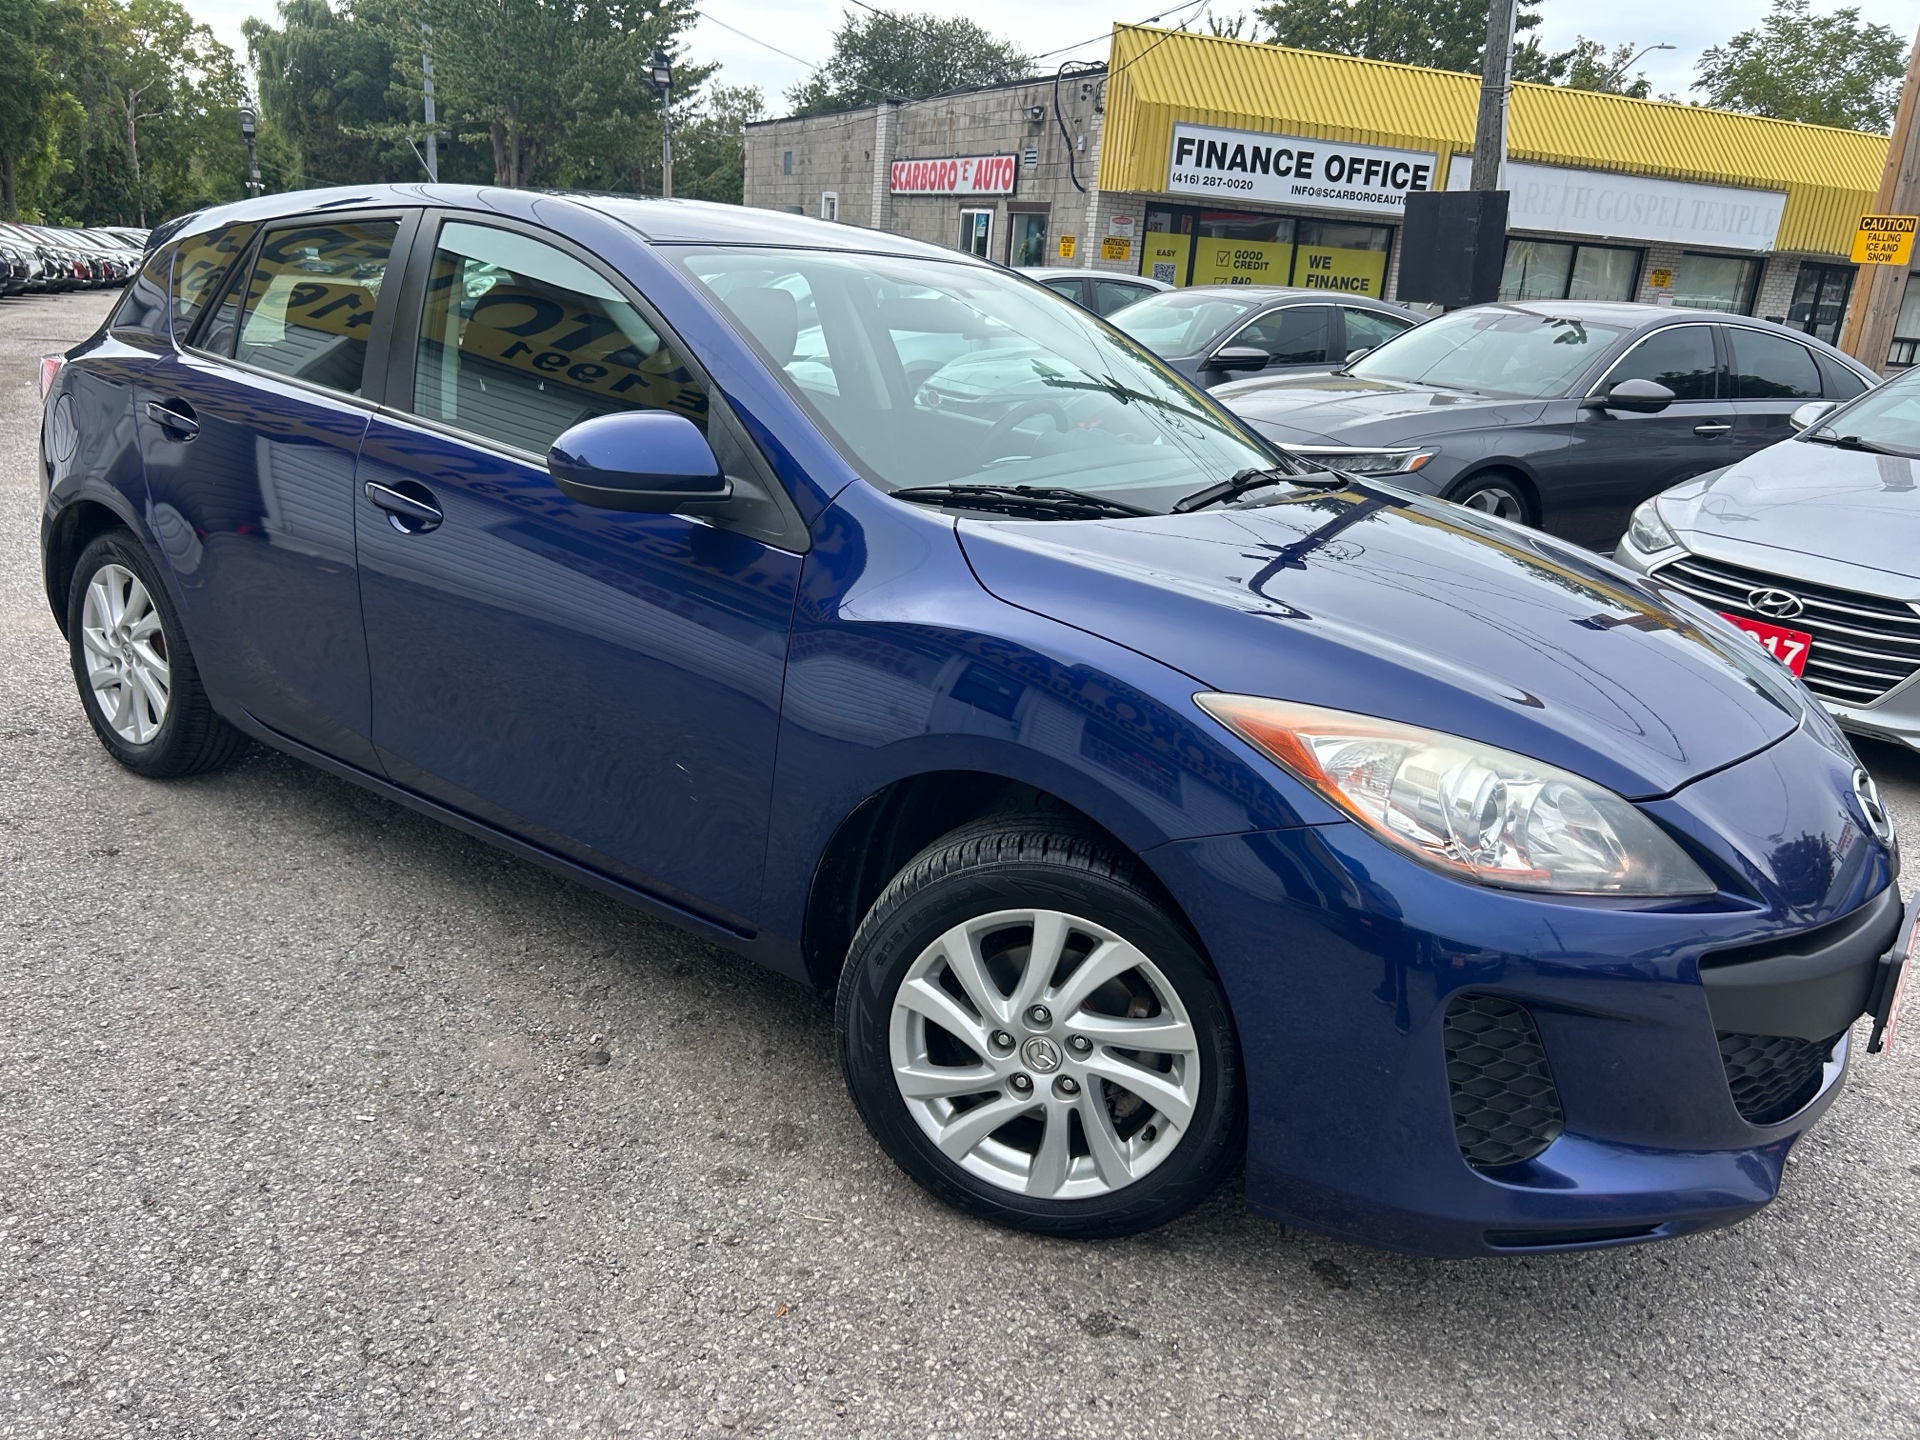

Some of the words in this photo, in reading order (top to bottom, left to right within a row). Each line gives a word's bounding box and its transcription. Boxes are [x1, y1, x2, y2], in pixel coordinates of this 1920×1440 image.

[1175, 137, 1314, 179] FINANCE
[1324, 154, 1430, 190] OFFICE
[891, 160, 958, 191] SCARBORO
[972, 157, 1014, 191] AUTO
[1172, 172, 1199, 185] (416)
[1202, 176, 1253, 190] 287-0020
[1595, 190, 1685, 229] GOSPEL
[1690, 199, 1778, 237] TEMPLE
[1862, 218, 1914, 231] CAUTION
[1104, 238, 1129, 246] CAUTION
[1867, 233, 1901, 242] FALLING
[1156, 249, 1176, 257] EASY
[1866, 243, 1879, 251] ICE
[1881, 243, 1899, 252] AND
[1234, 250, 1263, 260] GOOD
[1867, 253, 1893, 262] SNOW
[1233, 260, 1270, 271] CREDIT
[1309, 255, 1332, 270] WE
[1230, 276, 1252, 285] BAD
[1305, 274, 1370, 291] FINANCE
